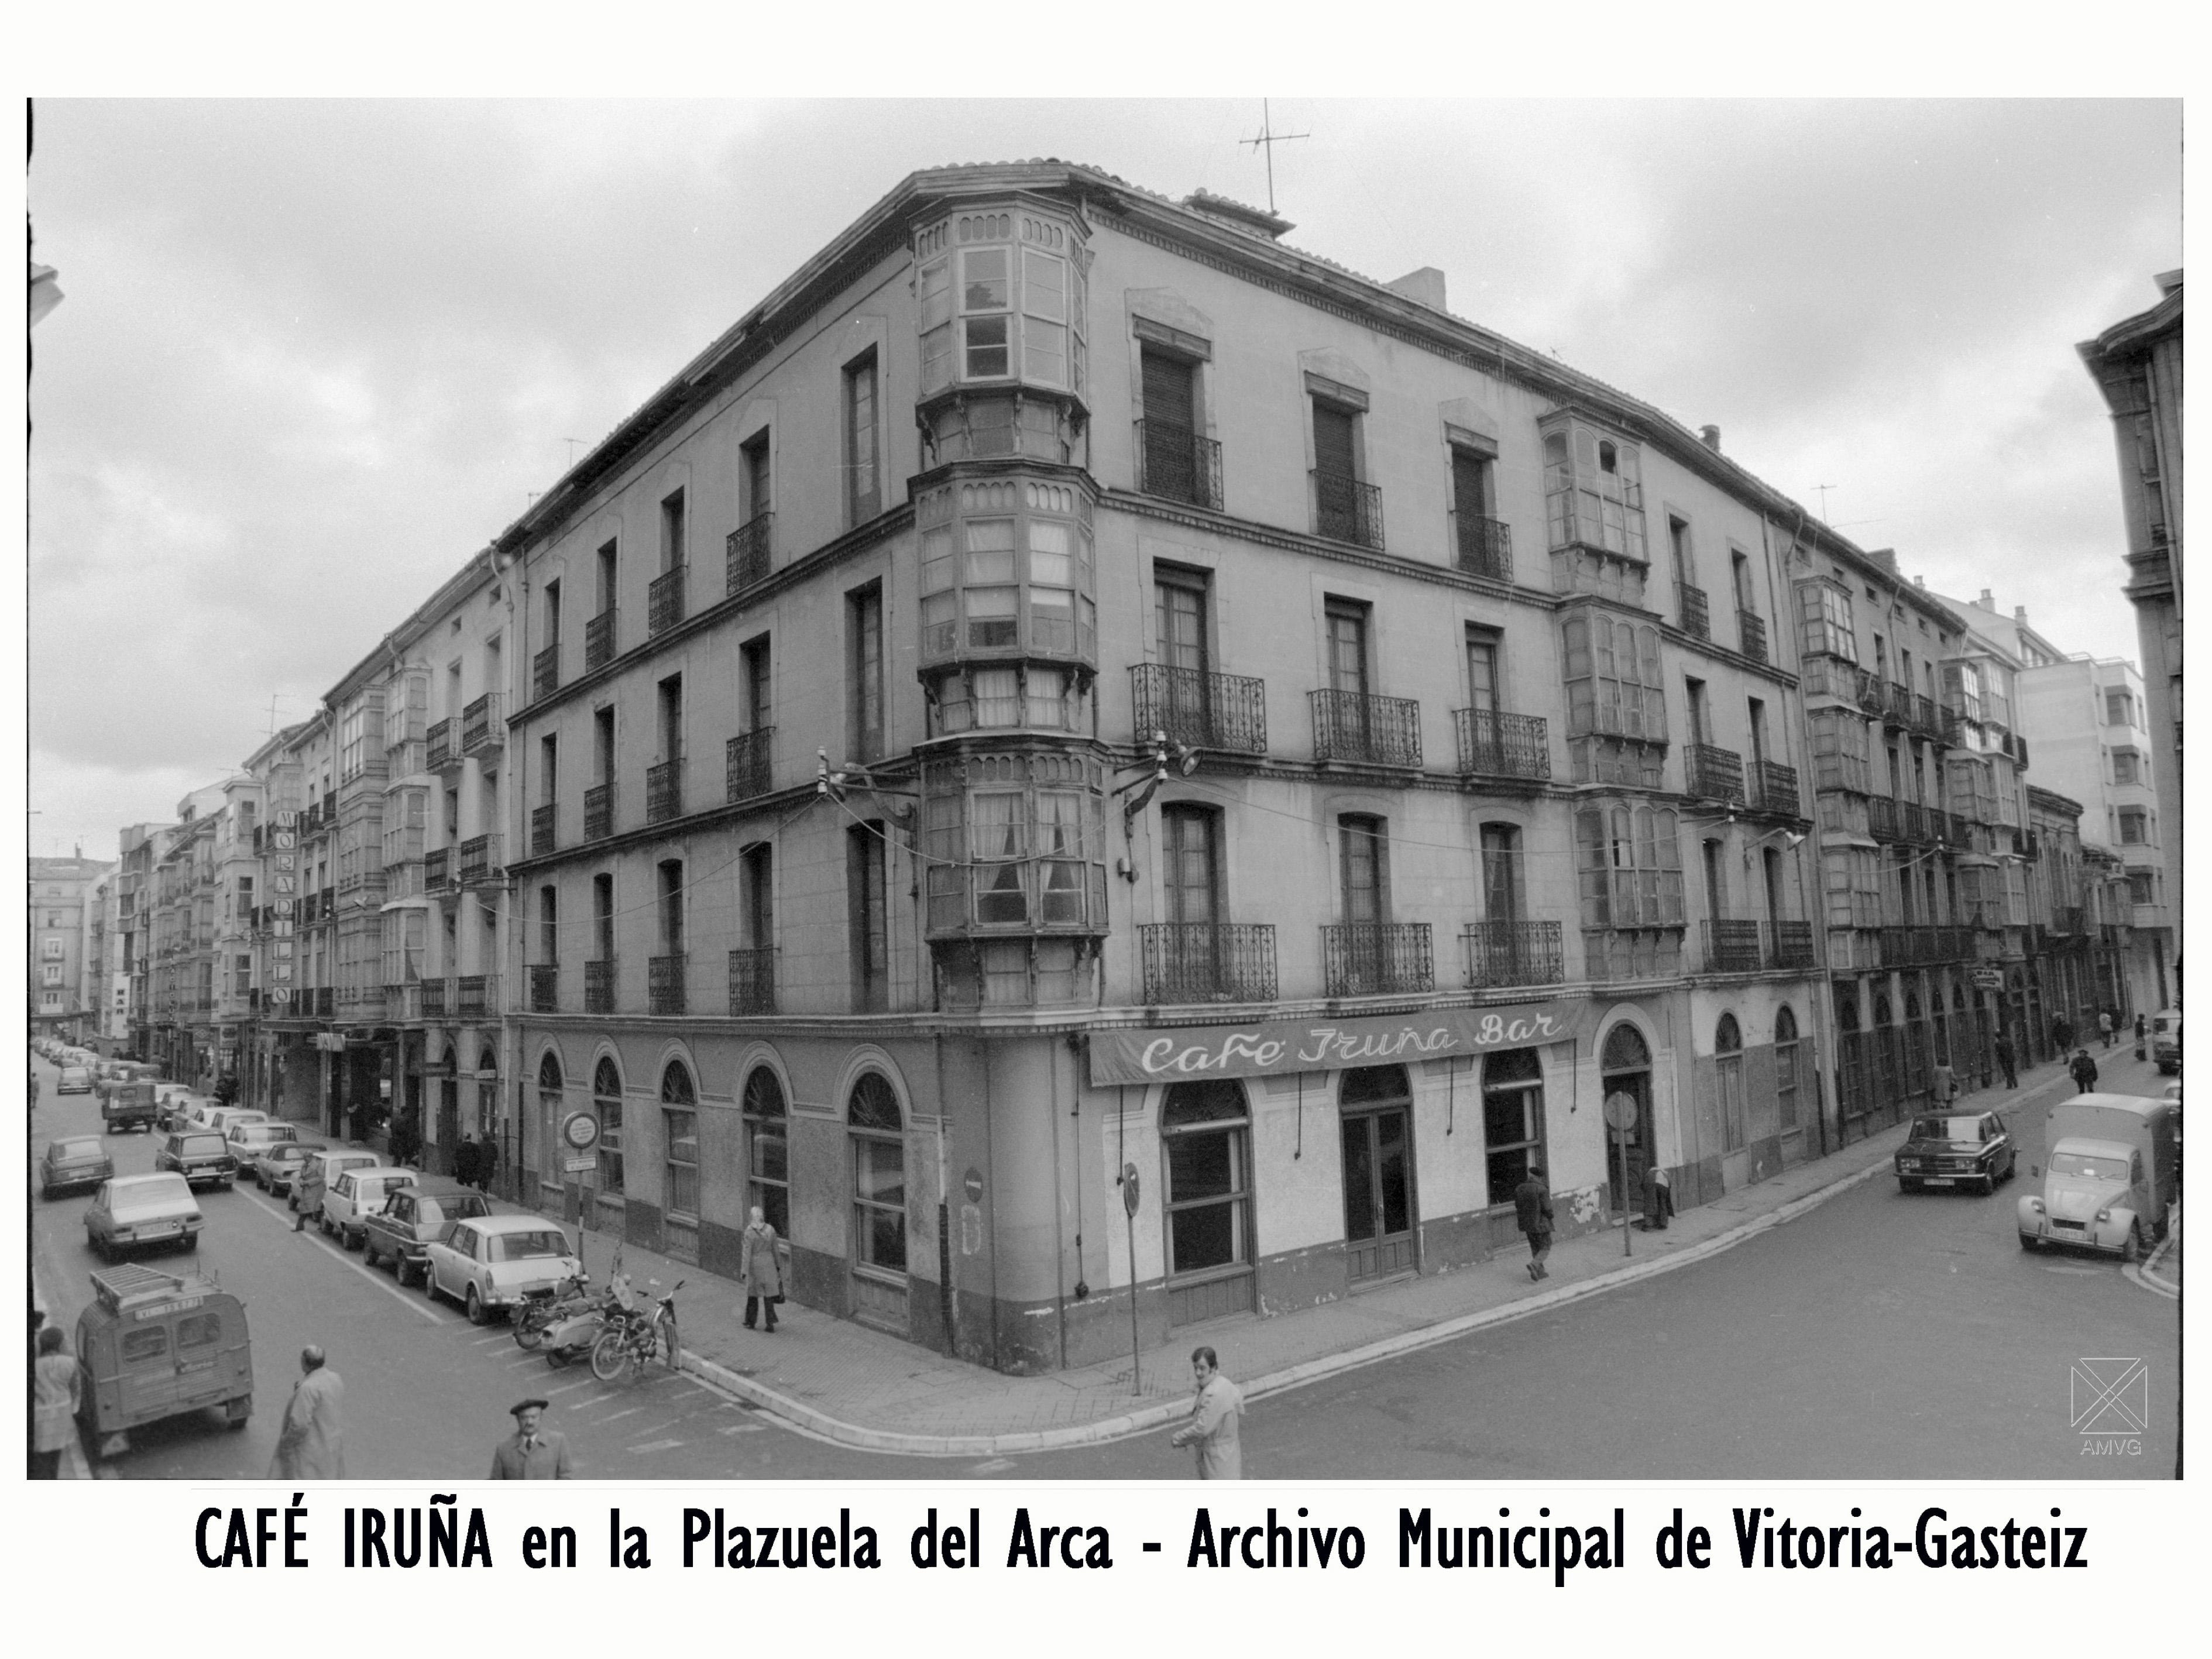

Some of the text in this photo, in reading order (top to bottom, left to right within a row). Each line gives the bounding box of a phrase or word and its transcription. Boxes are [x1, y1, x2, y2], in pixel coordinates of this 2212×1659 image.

[276, 812, 292, 1002] MORADILLO
[1142, 1013, 1562, 1072] Café Iruña Bar
